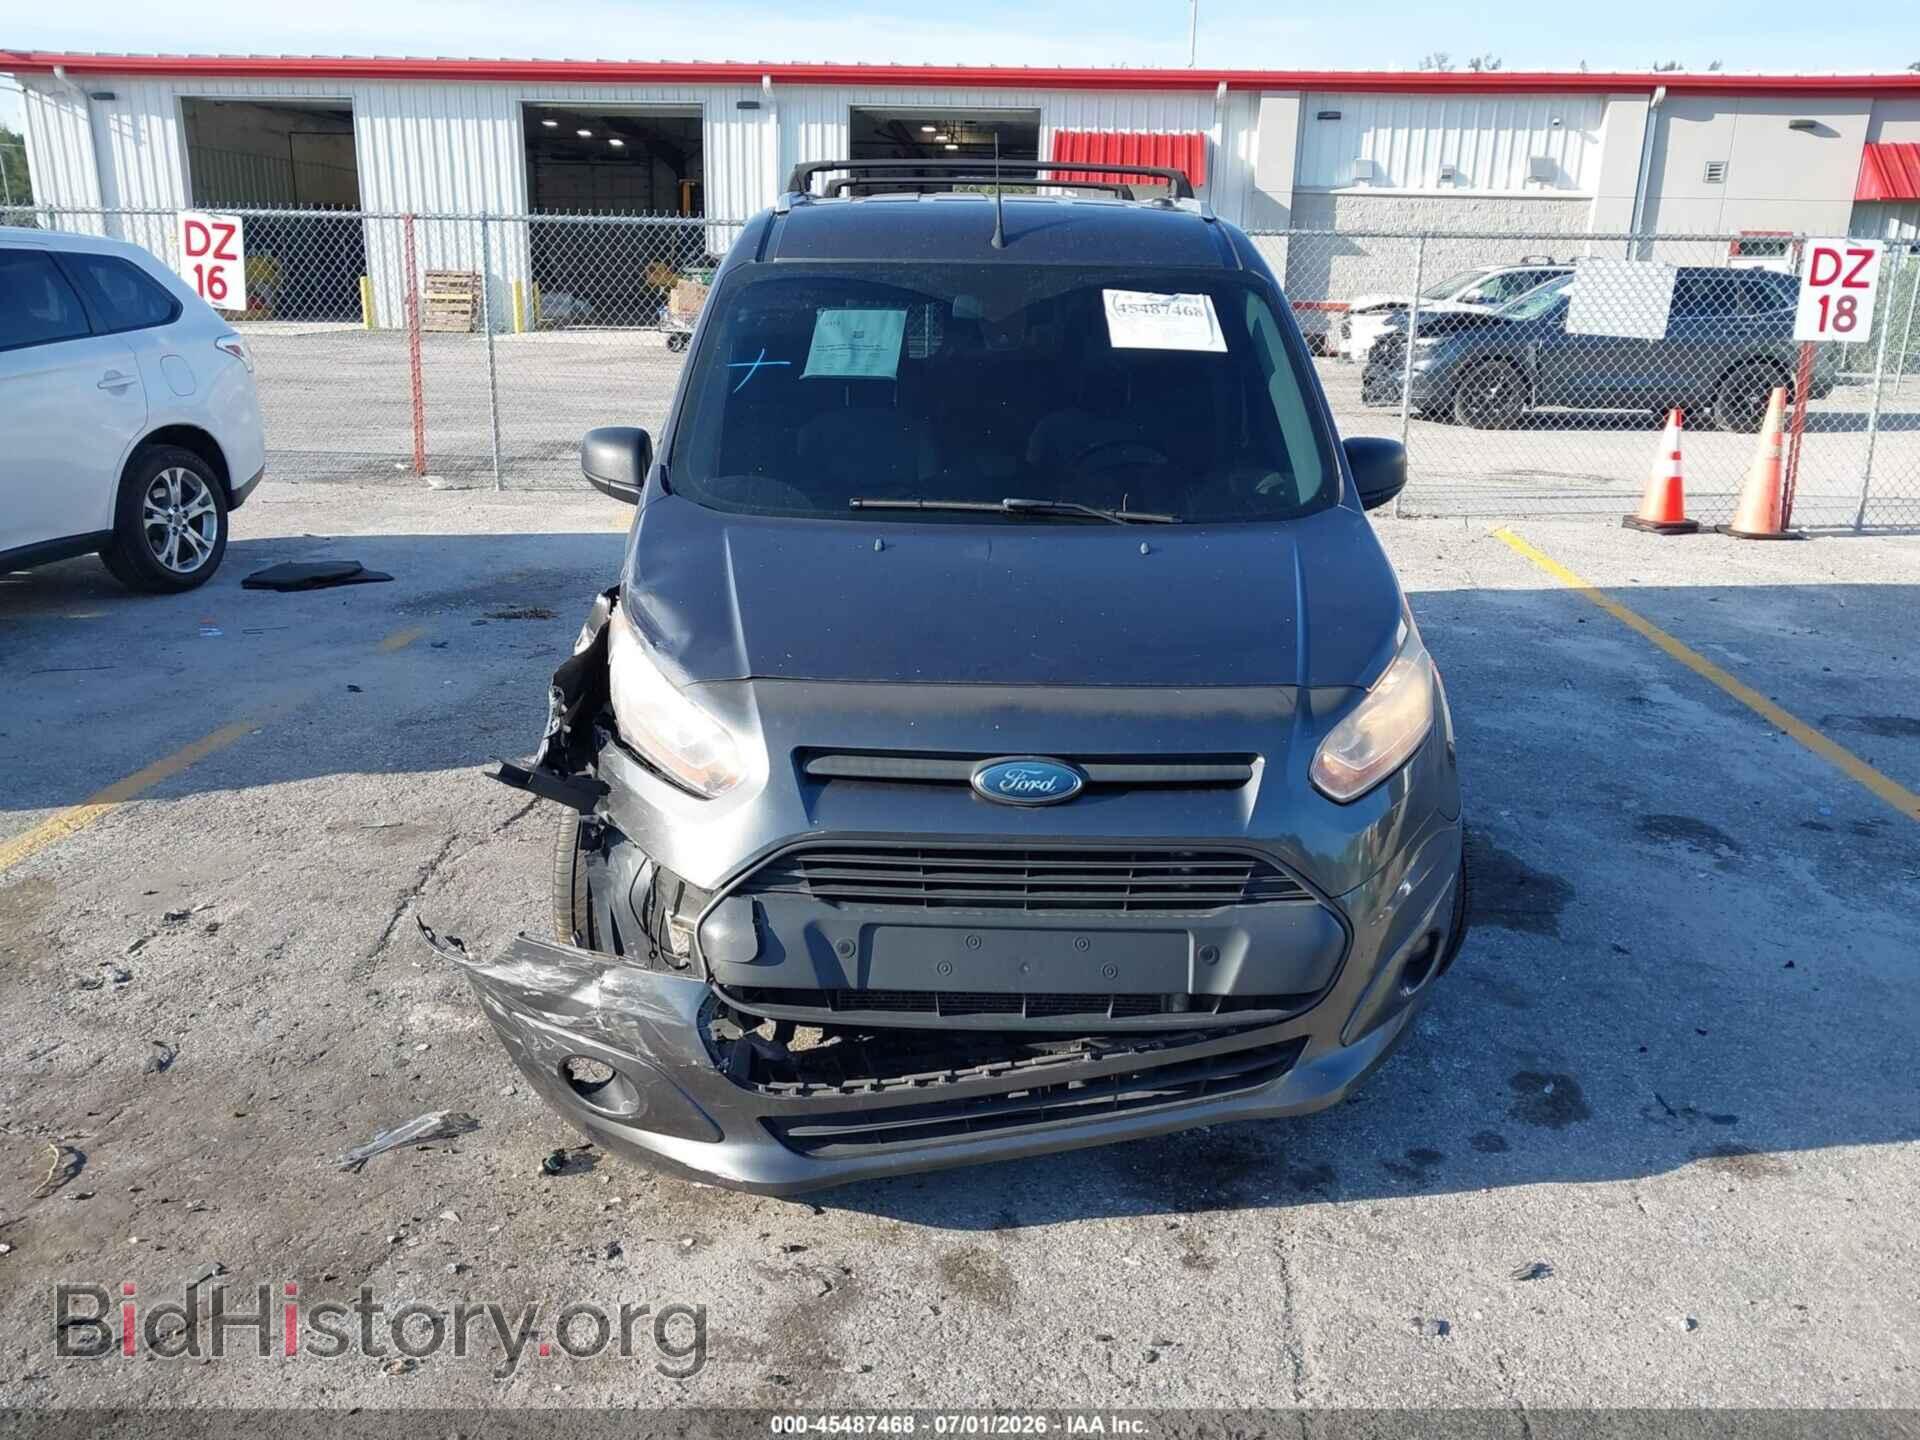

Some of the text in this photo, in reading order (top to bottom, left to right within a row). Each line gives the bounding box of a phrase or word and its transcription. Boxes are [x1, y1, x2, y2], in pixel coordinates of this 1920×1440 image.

[184, 220, 237, 260] DZ
[193, 264, 227, 300] 16
[1809, 248, 1874, 288] DZ
[1116, 302, 1204, 318] 45487468
[1818, 295, 1857, 332] 18
[999, 768, 1058, 792] Ford
